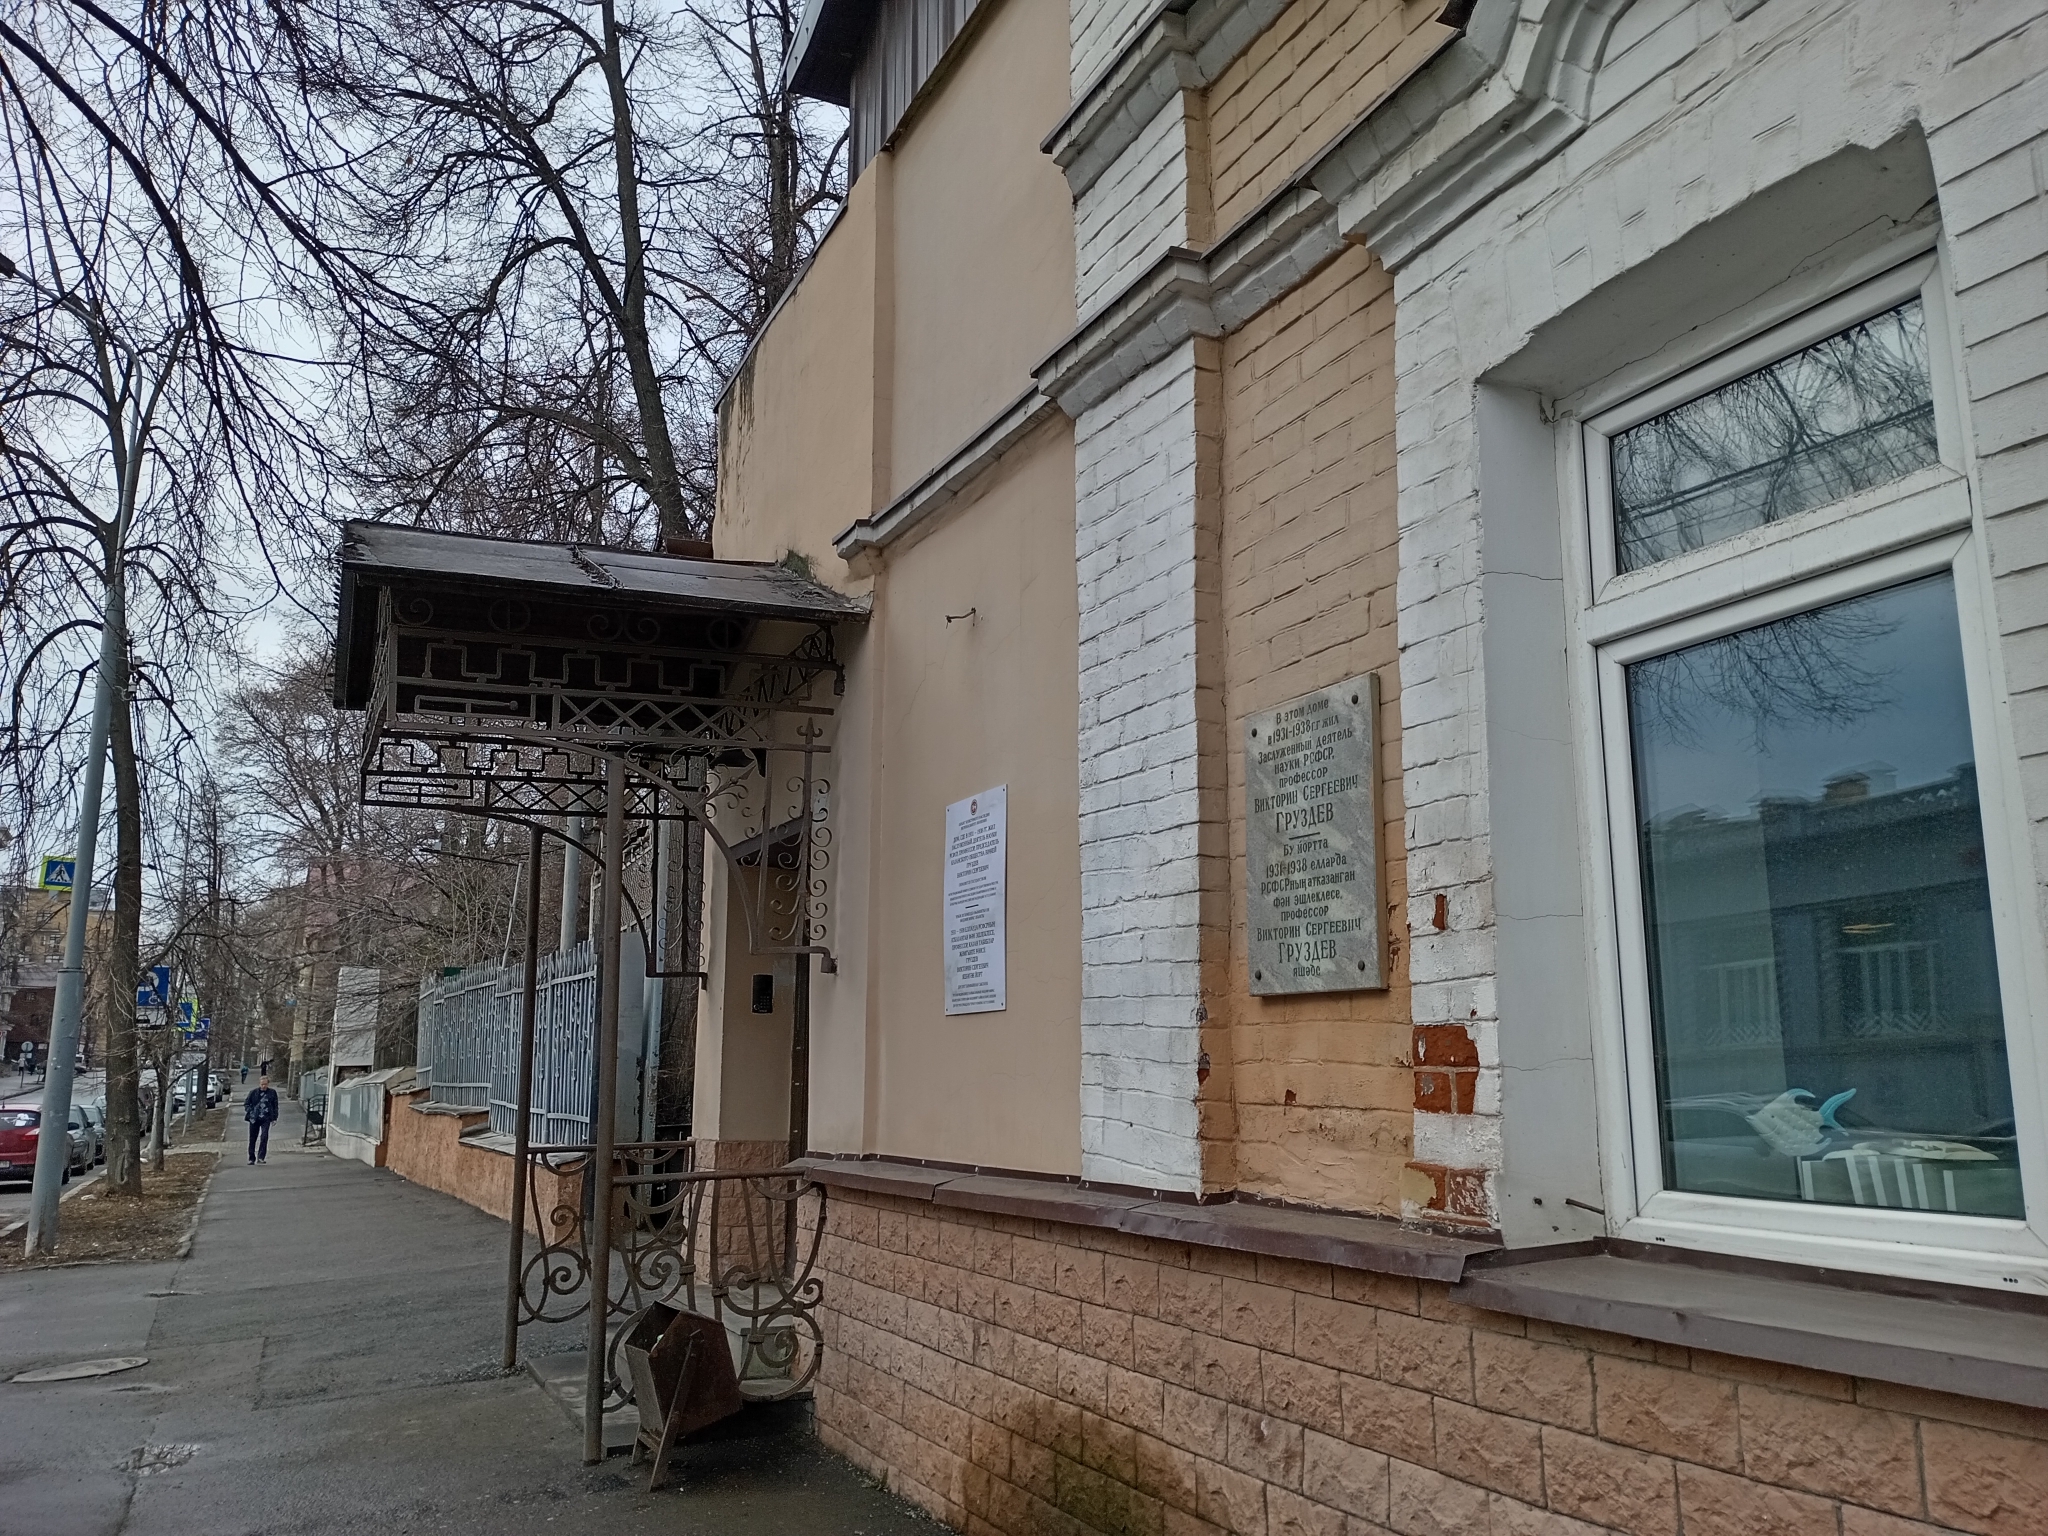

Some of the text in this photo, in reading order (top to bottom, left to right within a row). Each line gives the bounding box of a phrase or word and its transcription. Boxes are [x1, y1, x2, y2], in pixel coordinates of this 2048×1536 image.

[1276, 699, 1328, 725] В этом доме
[1321, 714, 1339, 729] жил
[1258, 726, 1353, 765] Заслуженный деятель
[1274, 758, 1300, 775] науки
[1279, 764, 1328, 788] профессор
[1276, 802, 1333, 833] ГРУЗДЕВ
[1284, 835, 1328, 856] Бу йортта
[1266, 851, 1347, 878] 1931-1938 елларда
[1308, 870, 1355, 888] атказанган
[1281, 904, 1329, 922] профессор
[1279, 937, 1337, 965] ГРУЗДЕВ
